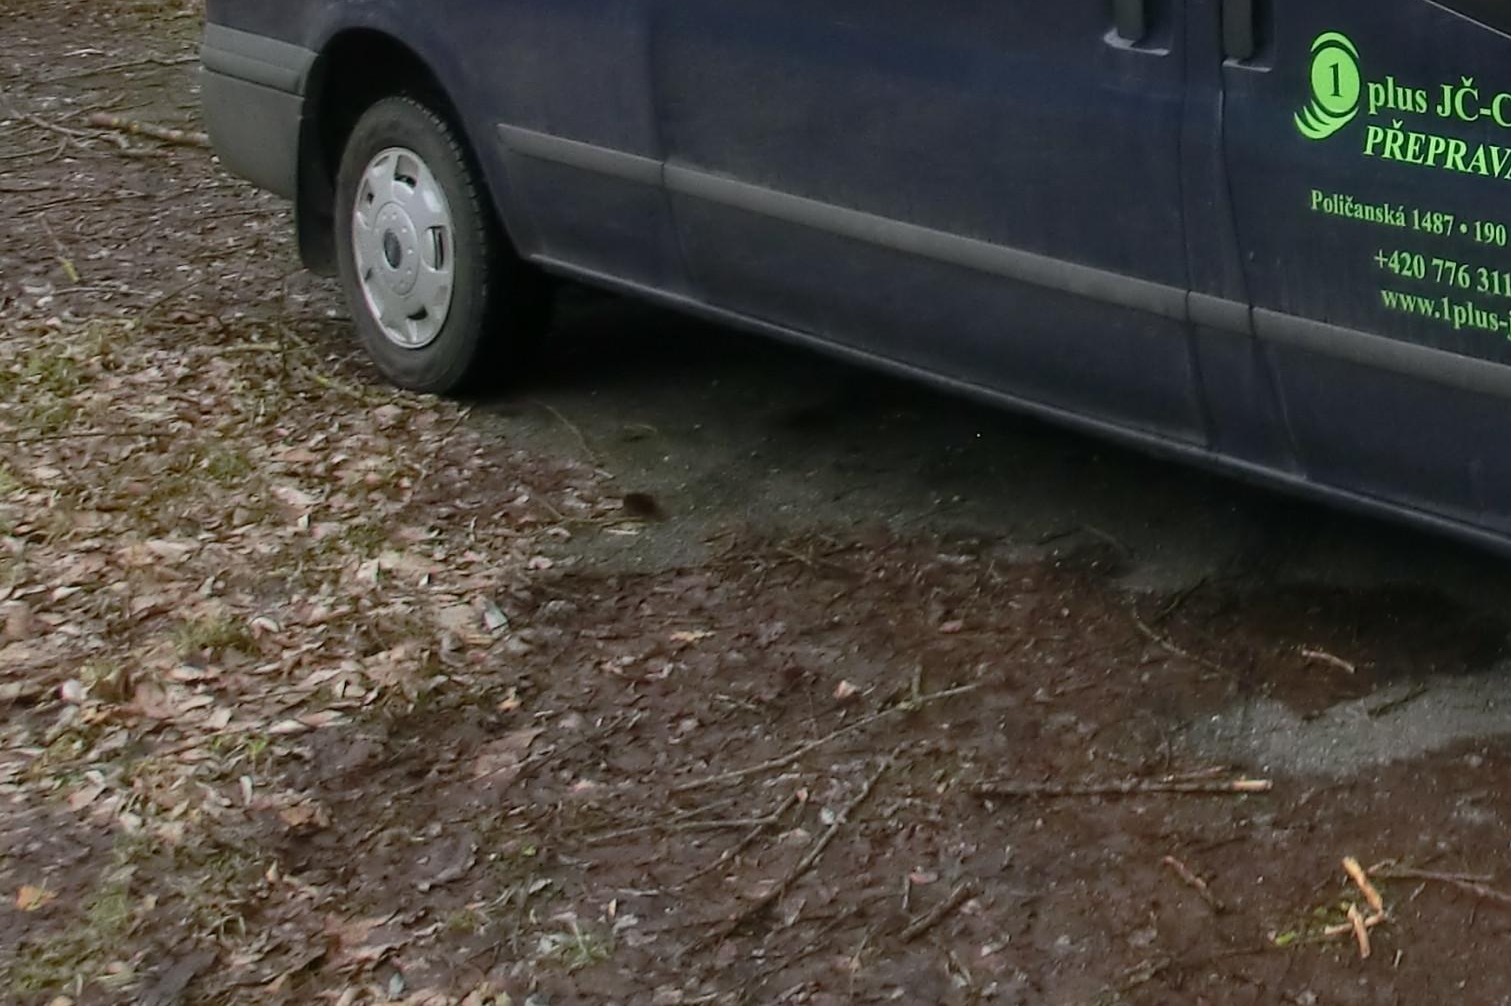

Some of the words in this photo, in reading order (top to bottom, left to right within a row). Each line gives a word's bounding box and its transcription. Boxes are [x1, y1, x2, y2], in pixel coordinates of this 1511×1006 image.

[1327, 62, 1341, 97] 1
[1367, 76, 1427, 115] plus
[1311, 190, 1405, 227] Poličanská
[1412, 209, 1454, 237] 1487
[1474, 221, 1506, 247] 190
[1374, 248, 1426, 279] +420
[1432, 258, 1470, 288] 776
